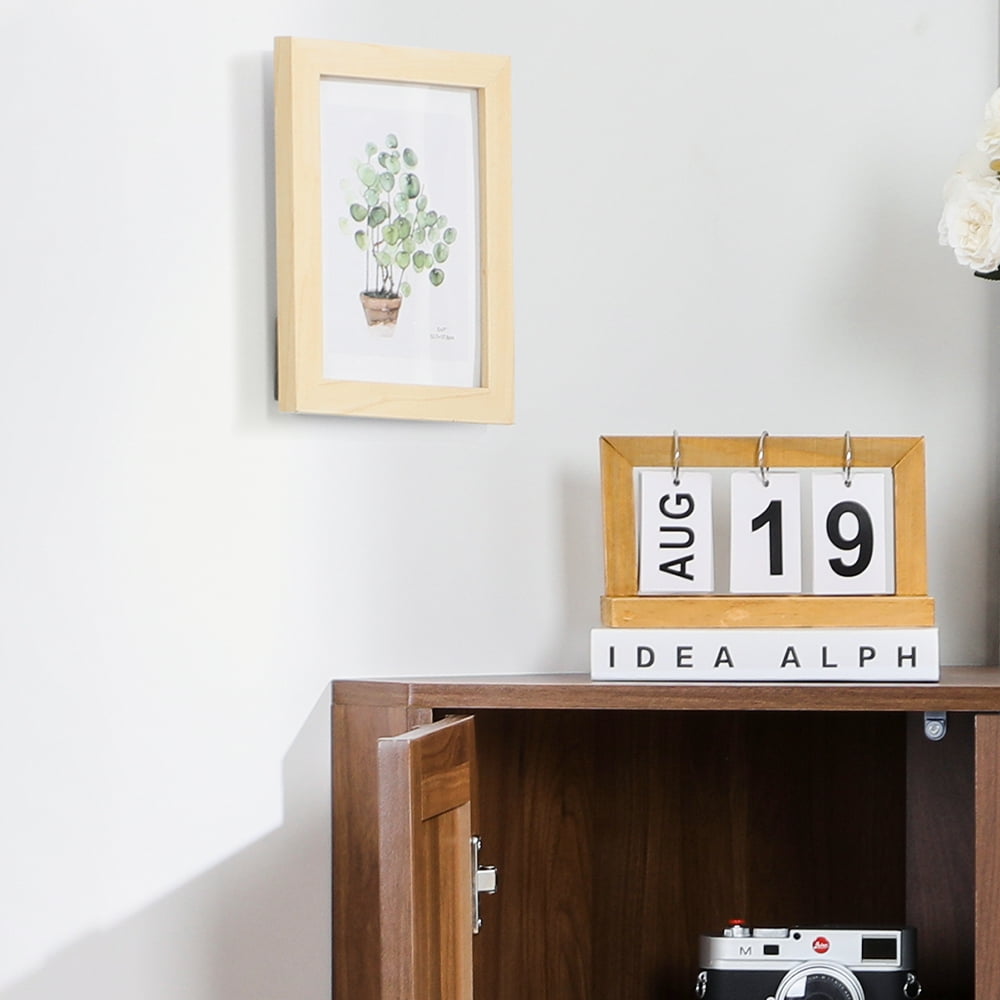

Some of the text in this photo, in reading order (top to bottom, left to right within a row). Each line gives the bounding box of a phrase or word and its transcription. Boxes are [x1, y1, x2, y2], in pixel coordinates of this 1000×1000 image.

[658, 493, 695, 581] AUG
[609, 646, 917, 668] IDEA ALPH
[739, 946, 752, 955] M
